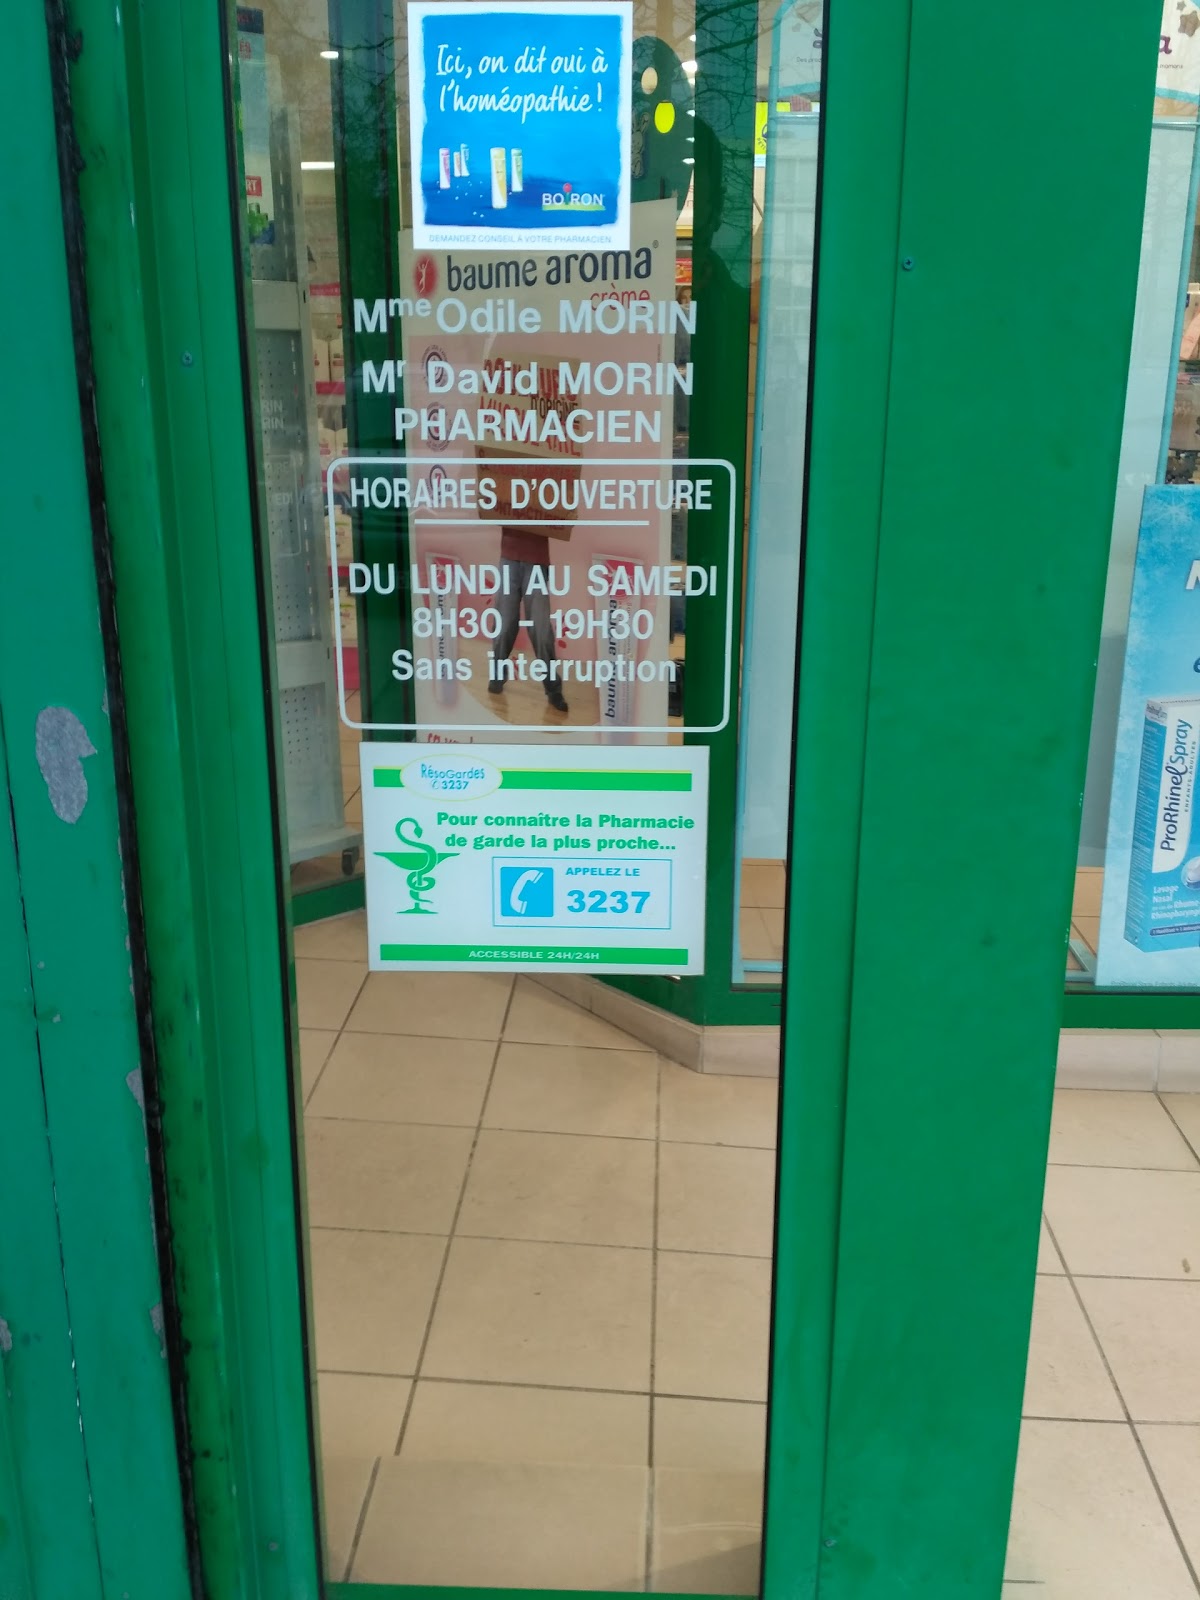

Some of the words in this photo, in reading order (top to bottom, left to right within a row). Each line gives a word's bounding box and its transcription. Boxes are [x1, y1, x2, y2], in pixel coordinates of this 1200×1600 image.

[436, 44, 472, 80] Ici,
[478, 55, 508, 74] on
[514, 45, 546, 73] dit
[551, 46, 586, 74] oui
[591, 47, 608, 73] à
[542, 190, 604, 206] BOIRON
[429, 234, 476, 243] DEMANDEZ
[478, 234, 516, 243] CONSEIL
[524, 235, 552, 243] VOTRE
[554, 235, 612, 244] PHARMACIEN
[447, 255, 537, 292] baume
[546, 247, 652, 285] aroma
[353, 297, 432, 333] Mme
[436, 298, 542, 334] Odile
[559, 300, 698, 336] MORIN
[362, 360, 407, 393] Mr
[427, 360, 538, 396] David
[559, 361, 695, 396] MORIN
[394, 408, 661, 443] PHARMACIEN
[351, 477, 497, 510] HORAIRES
[510, 478, 713, 511] D'OUVERTURE
[348, 563, 395, 595] DU
[412, 564, 510, 596] LUNDI
[525, 565, 571, 596] AU
[587, 565, 717, 597] SAMEDI
[412, 608, 502, 639] 8H30
[549, 608, 655, 640] 19H30
[392, 649, 472, 682] Sans
[487, 651, 676, 689] interruption
[1169, 719, 1193, 765] Spray
[442, 780, 469, 790] 3237
[437, 812, 478, 826] Pour
[484, 812, 570, 828] connaître
[576, 814, 592, 828] la
[599, 814, 695, 829] Pharmacie
[1160, 764, 1188, 851] ProRhinel
[445, 834, 467, 847] de
[473, 834, 525, 850] garde
[531, 835, 547, 848] la
[553, 836, 591, 851] plus
[597, 836, 676, 852] proche...
[565, 867, 621, 877] APPELEZ
[625, 867, 641, 877] LE
[567, 889, 651, 914] 3237
[469, 950, 543, 959] ACCESSIBLE
[547, 951, 600, 960] 24H/24H
